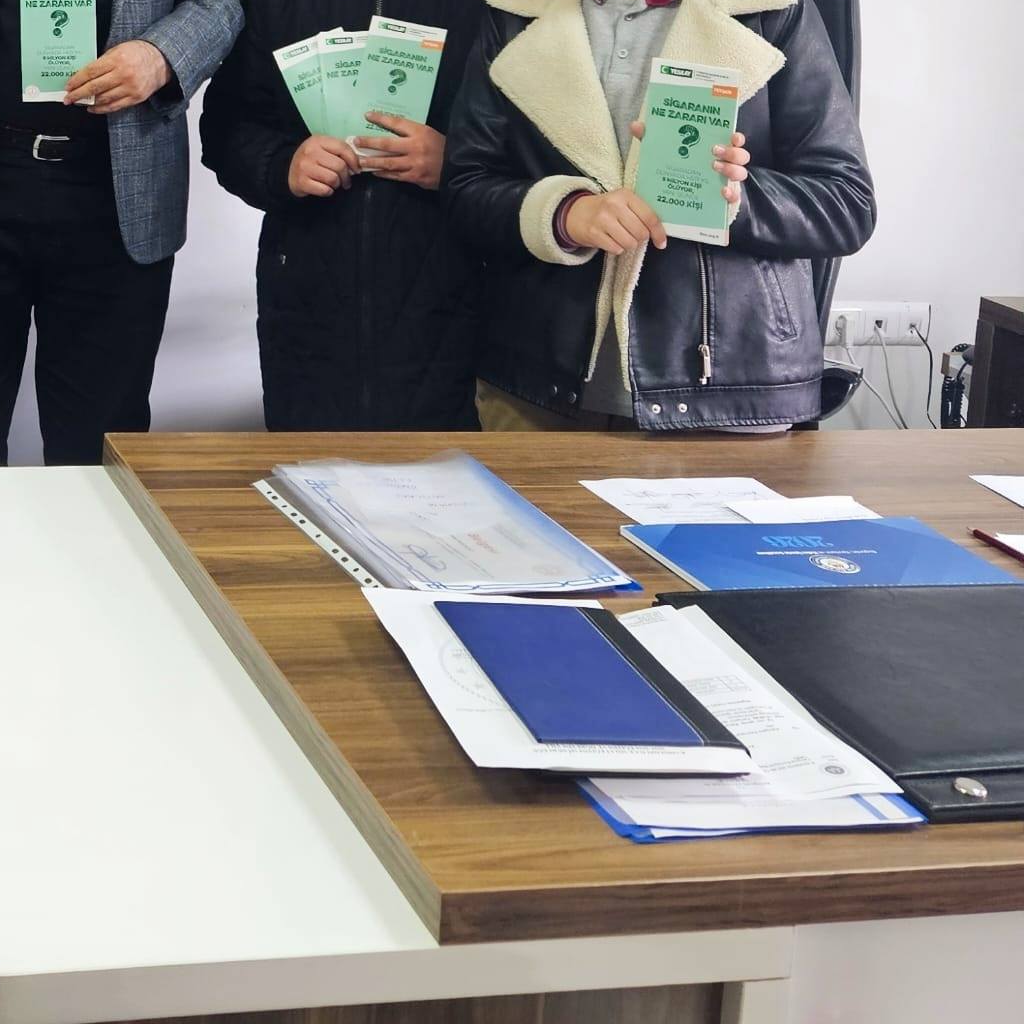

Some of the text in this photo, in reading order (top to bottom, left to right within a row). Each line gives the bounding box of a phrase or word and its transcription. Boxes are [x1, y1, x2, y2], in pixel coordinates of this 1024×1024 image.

[39, 0, 73, 8] ZARARI
[74, 0, 93, 7] VAR
[663, 97, 721, 115] SİGARANIN
[651, 107, 730, 129] NE ZARARI VAR
[656, 195, 704, 211] 22.000 KİŞİ
